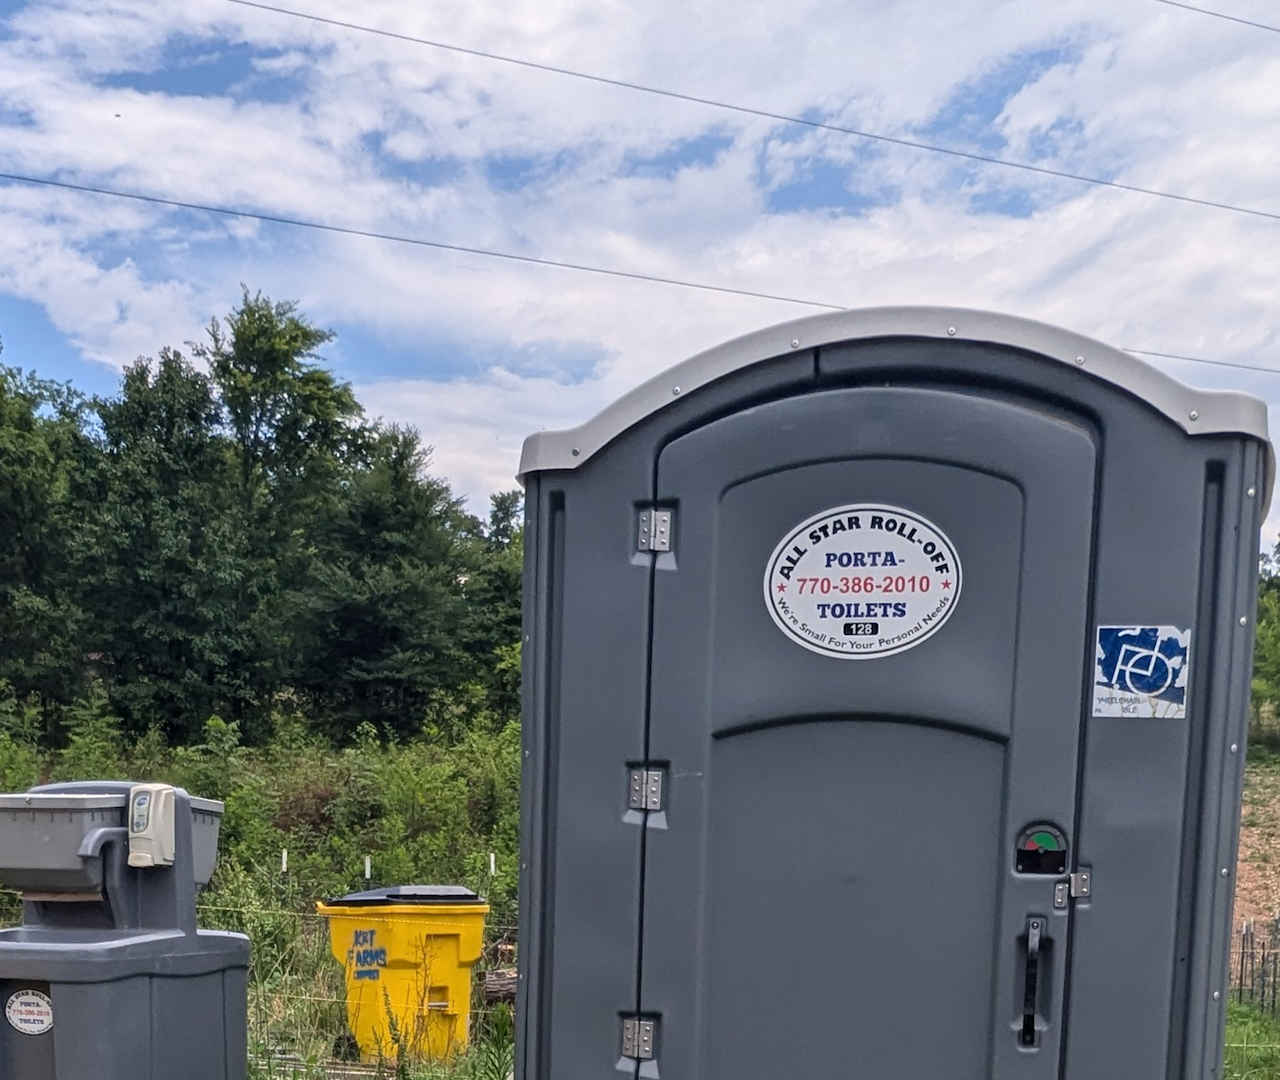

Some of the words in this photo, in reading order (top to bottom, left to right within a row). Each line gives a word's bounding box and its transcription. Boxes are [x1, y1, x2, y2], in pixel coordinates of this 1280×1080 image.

[779, 546, 808, 580] ALL
[809, 516, 861, 545] STAR
[870, 515, 950, 575] ROLL-OFF
[825, 551, 905, 568] PORTA-
[796, 575, 930, 594] 770-386-2010
[817, 602, 906, 619] TOILETS
[778, 597, 799, 626] We're
[799, 622, 826, 643] Small
[828, 637, 847, 648] For
[848, 641, 874, 649] Your
[878, 622, 923, 648] Personal
[923, 596, 950, 625] Needs
[850, 624, 872, 635] 128
